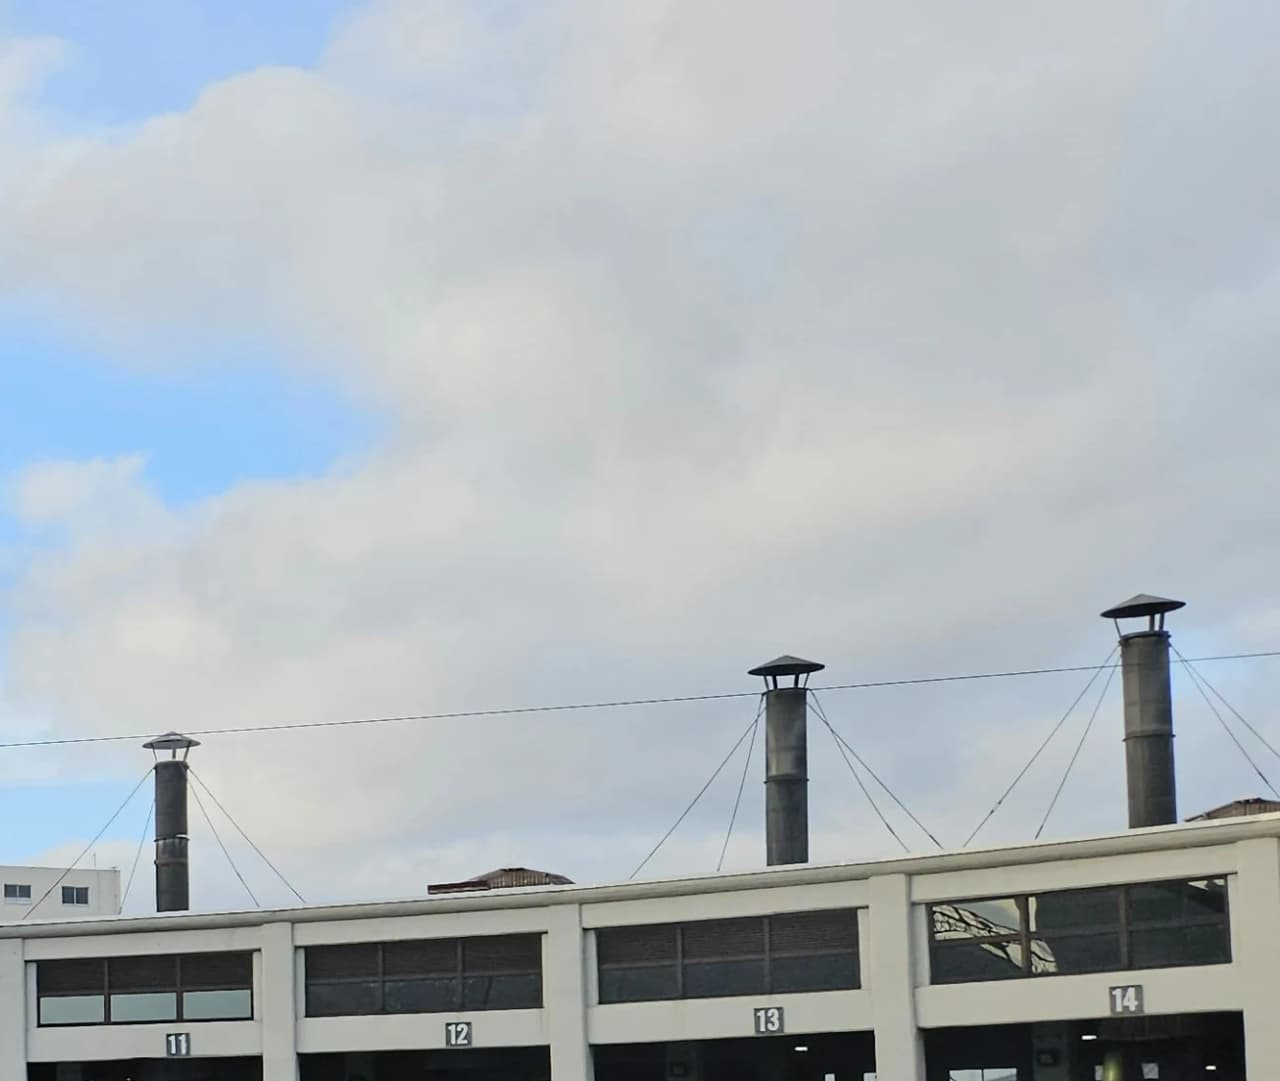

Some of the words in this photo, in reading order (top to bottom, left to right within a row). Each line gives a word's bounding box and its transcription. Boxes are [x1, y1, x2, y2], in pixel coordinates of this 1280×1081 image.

[1112, 987, 1139, 1012] 14
[756, 1008, 779, 1031] 13
[167, 1034, 187, 1055] 11
[447, 1023, 469, 1045] 12
